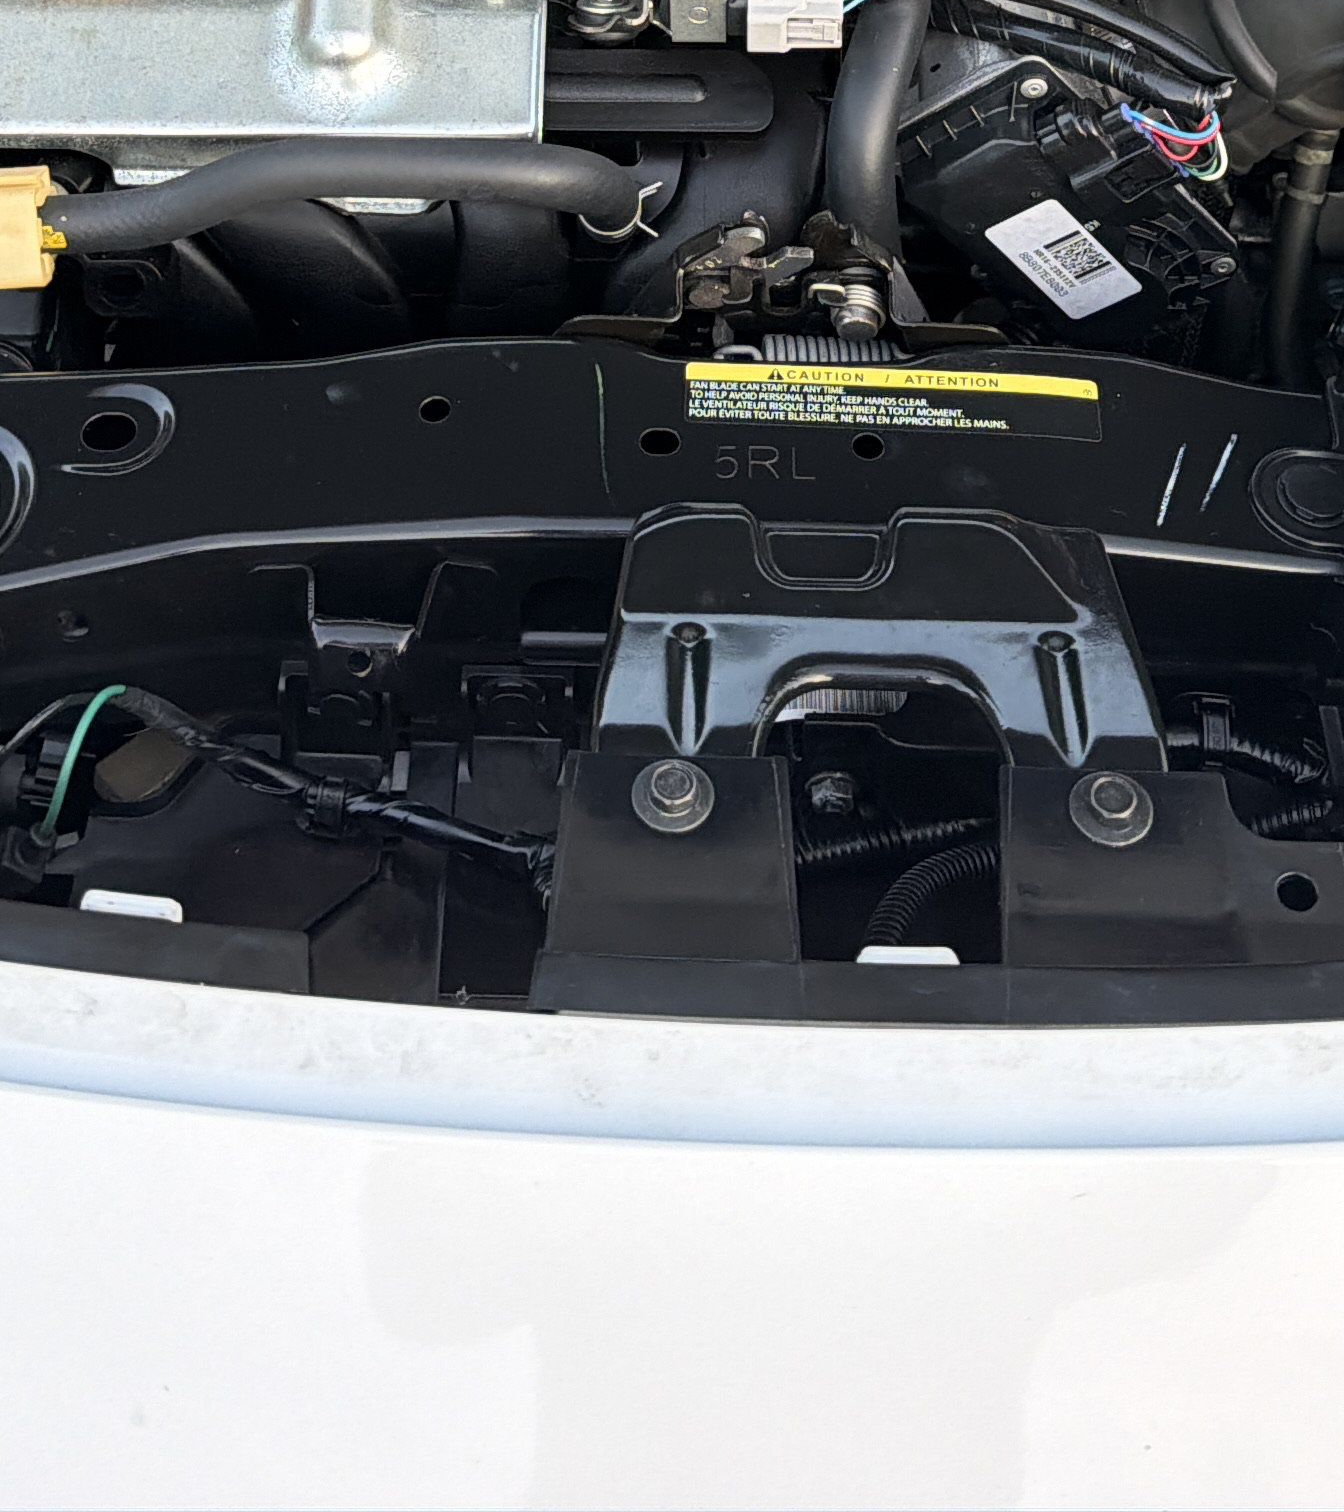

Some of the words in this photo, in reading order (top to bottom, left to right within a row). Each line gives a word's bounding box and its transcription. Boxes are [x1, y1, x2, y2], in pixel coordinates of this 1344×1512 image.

[690, 381, 708, 389] FAN
[709, 382, 739, 390] BLADE
[740, 383, 760, 391] CAN
[761, 383, 789, 392] START
[790, 384, 801, 392] AT
[803, 385, 822, 393] ANY
[786, 370, 865, 383] CAUTION
[904, 374, 1000, 388] ATTENTION
[690, 390, 703, 399] TO
[705, 391, 727, 400] HELP
[728, 391, 757, 401] AVOID
[758, 392, 805, 402] PERSONAL
[841, 395, 862, 404] KEEP
[864, 396, 896, 406] HANDS
[689, 399, 700, 408] LE
[702, 400, 766, 410] VENTILATEUR
[768, 402, 805, 412] RISQUE
[807, 403, 821, 412] DE
[888, 406, 914, 415] TOUT
[917, 407, 965, 417] MOMENT.
[689, 409, 717, 419] POUR
[754, 411, 785, 421] TOUTE
[840, 414, 854, 424] NE
[856, 415, 874, 424] PAS
[877, 415, 890, 425] EN
[893, 416, 952, 427] APPROCHER
[955, 418, 971, 428] LES
[973, 419, 1009, 429] MAINS.
[715, 445, 816, 479] 5RL
